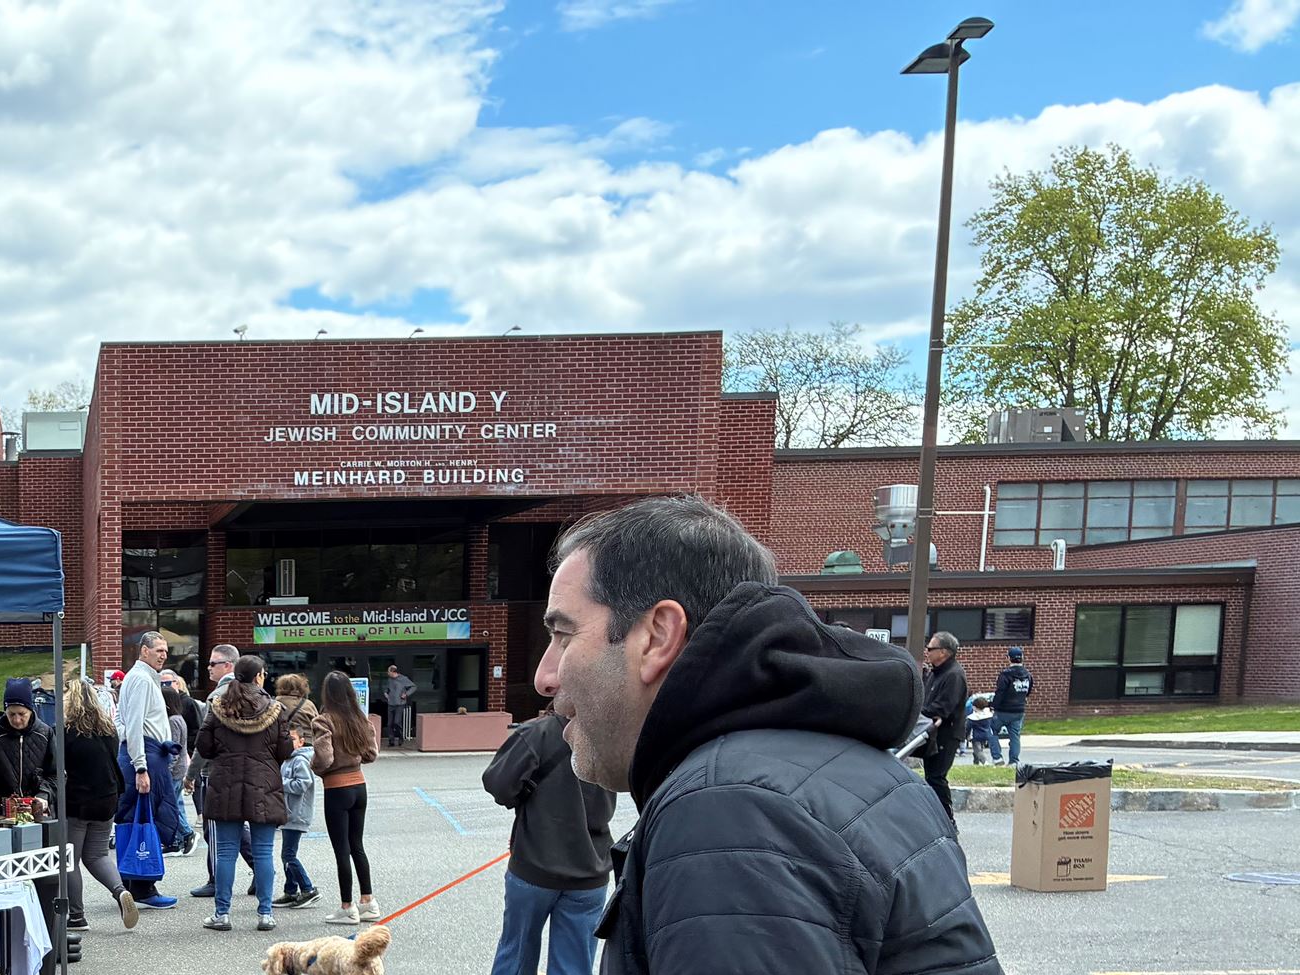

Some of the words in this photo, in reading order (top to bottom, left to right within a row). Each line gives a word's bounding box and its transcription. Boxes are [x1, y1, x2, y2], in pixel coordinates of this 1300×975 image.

[310, 391, 476, 414] MID-ISLAND
[490, 391, 507, 412] Y
[264, 426, 337, 442] JEWISH
[352, 425, 466, 440] COMMUNITY
[480, 423, 557, 439] CENTER
[340, 460, 372, 468] CARRIE
[449, 459, 478, 467] HENRY
[294, 470, 406, 485] MEINHARD
[423, 468, 525, 484] BUILDING
[258, 611, 331, 626] WELCOME
[333, 615, 344, 624] to
[345, 613, 360, 624] the
[362, 608, 427, 624] Mid-Island
[430, 609, 440, 622] Y
[440, 608, 467, 621] JCC
[282, 628, 305, 638] THE
[309, 627, 357, 637] CENTER
[368, 626, 385, 635] OF
[389, 626, 400, 635] IT
[403, 625, 425, 635] ALL
[1060, 793, 1094, 827] HOME
